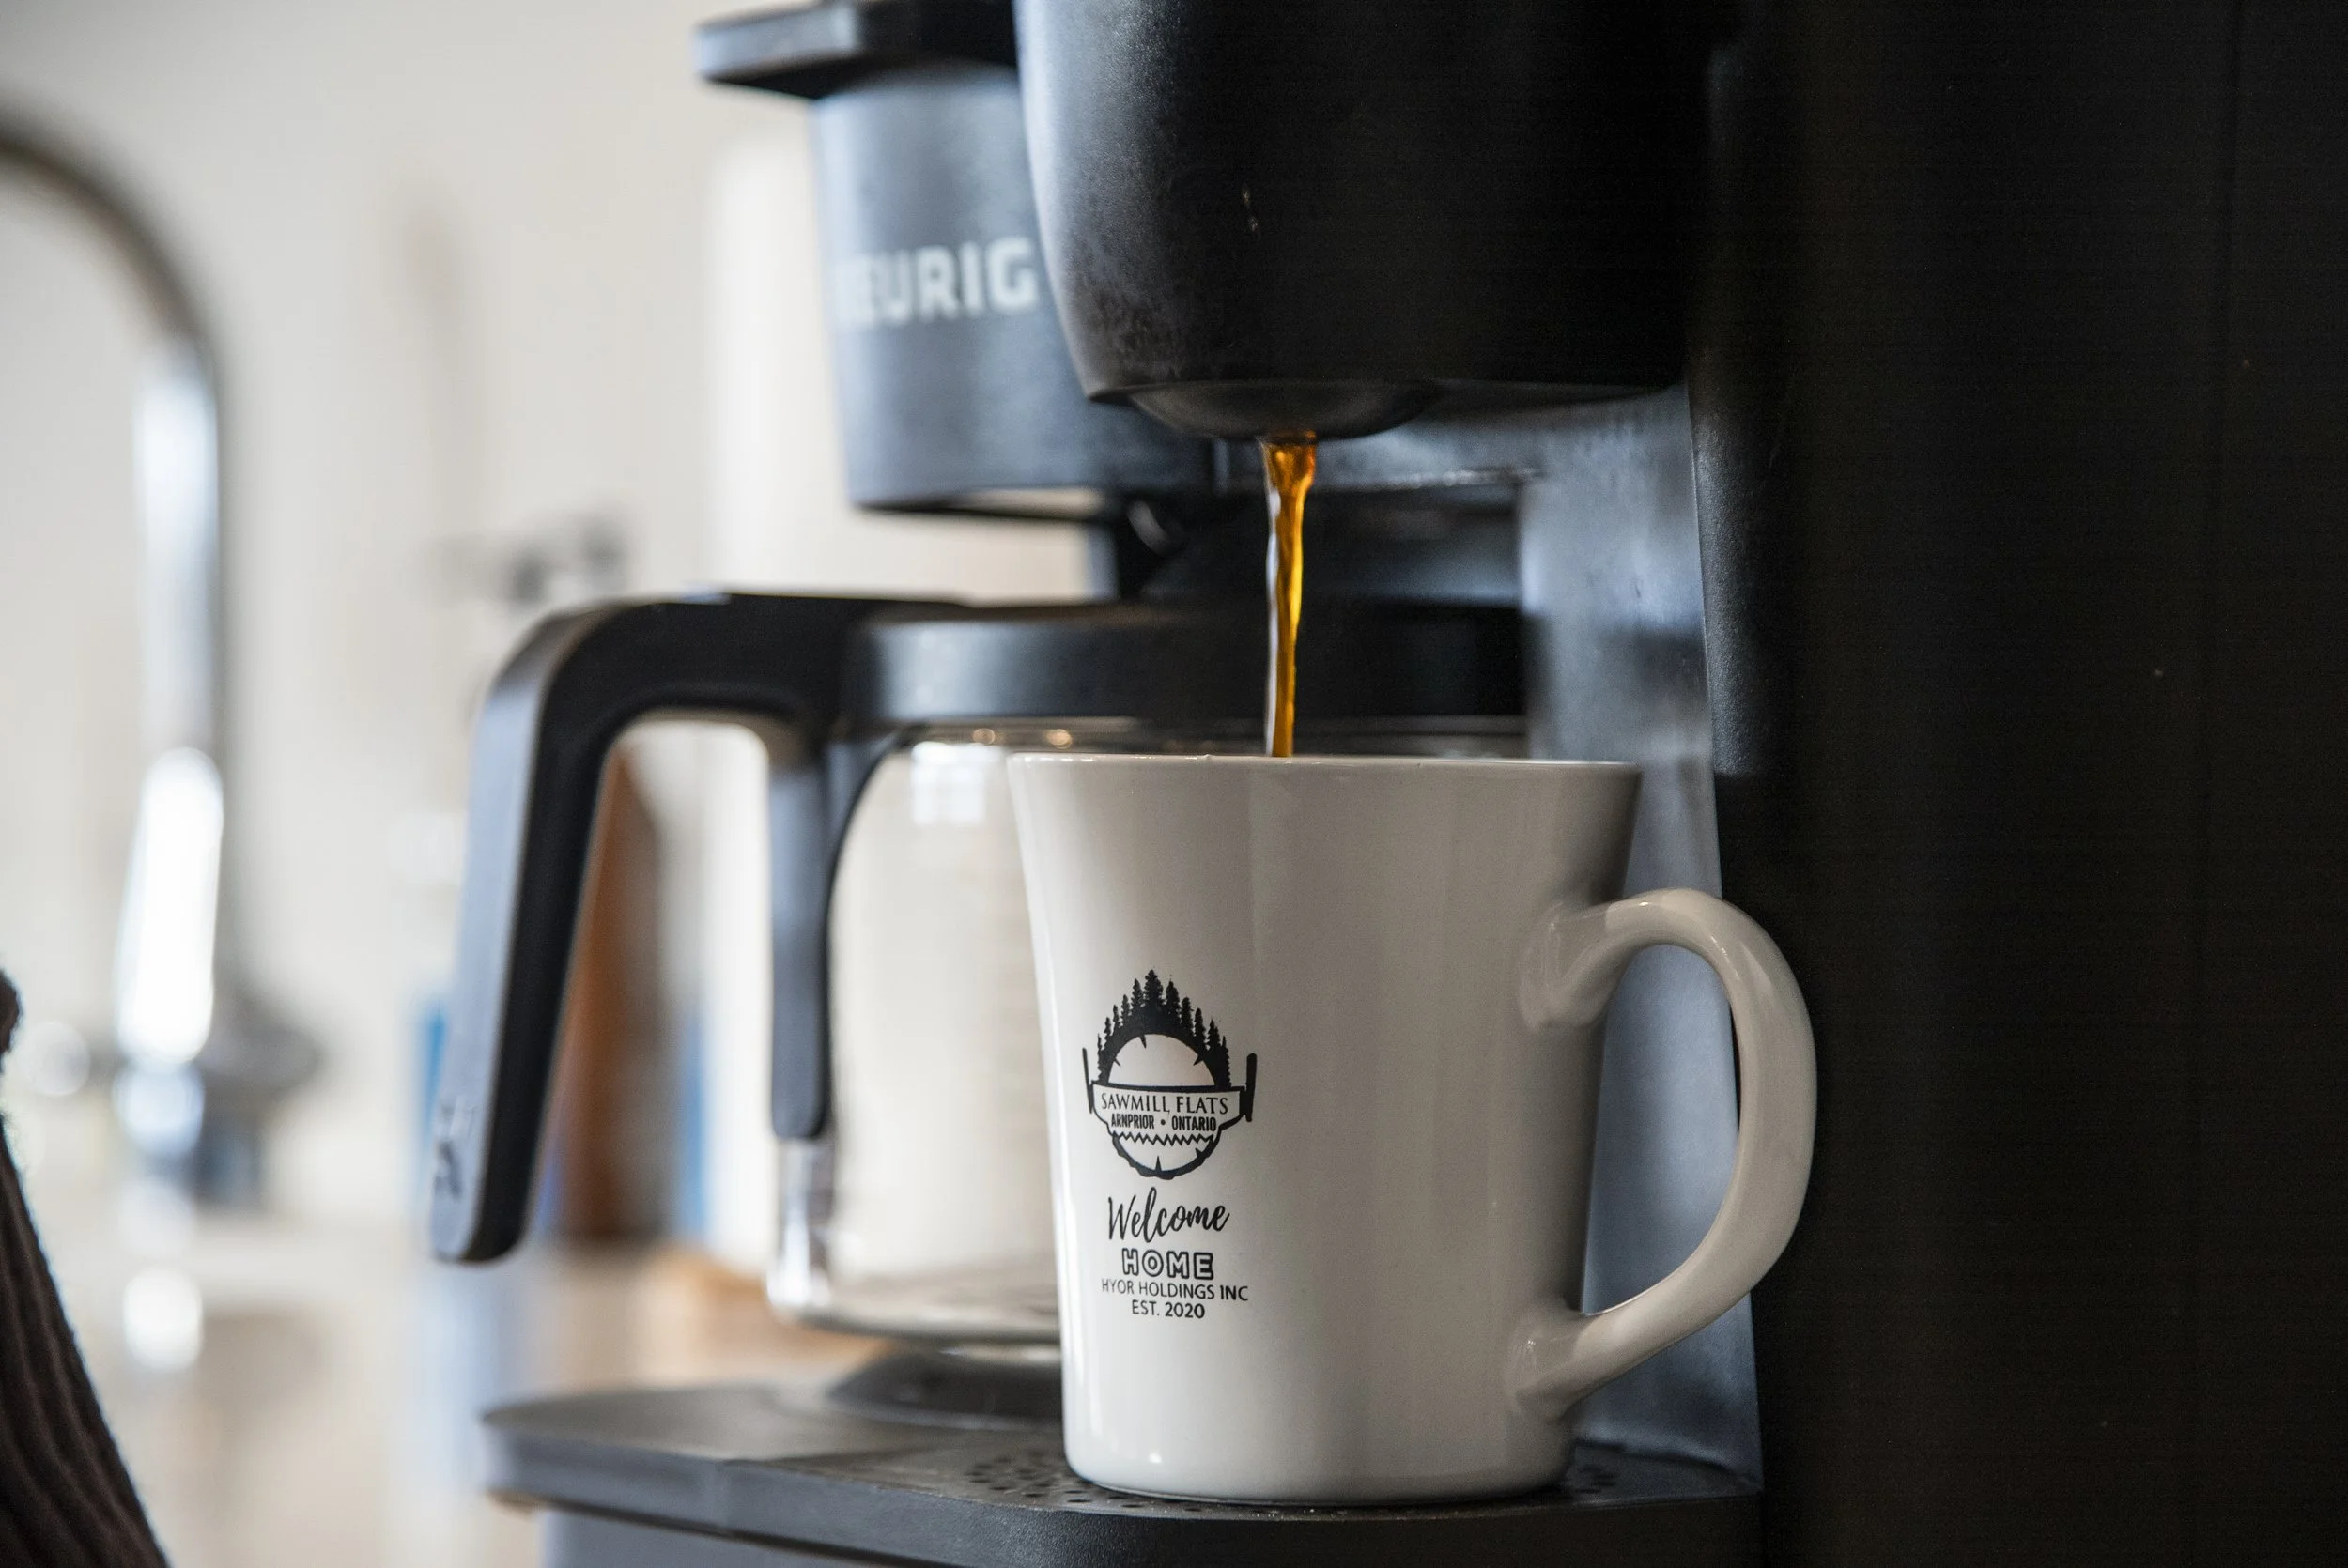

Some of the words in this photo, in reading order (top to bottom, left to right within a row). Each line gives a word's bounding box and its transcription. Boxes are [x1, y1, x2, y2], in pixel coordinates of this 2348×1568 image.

[833, 236, 1039, 329] EURIG
[1101, 1092, 1170, 1115] SAWMILL
[1176, 1095, 1228, 1115] FLATS
[1110, 1113, 1155, 1130] ARNPRIOR
[1171, 1115, 1217, 1132] ONTARIO
[1107, 1186, 1231, 1244] Welcome
[1121, 1247, 1215, 1281] HOME
[1101, 1278, 1135, 1296] HYOR
[1138, 1281, 1216, 1300] HOLDINGS
[1220, 1285, 1250, 1302] INC
[1131, 1299, 1161, 1316] EST.
[1165, 1301, 1206, 1319] 2020
